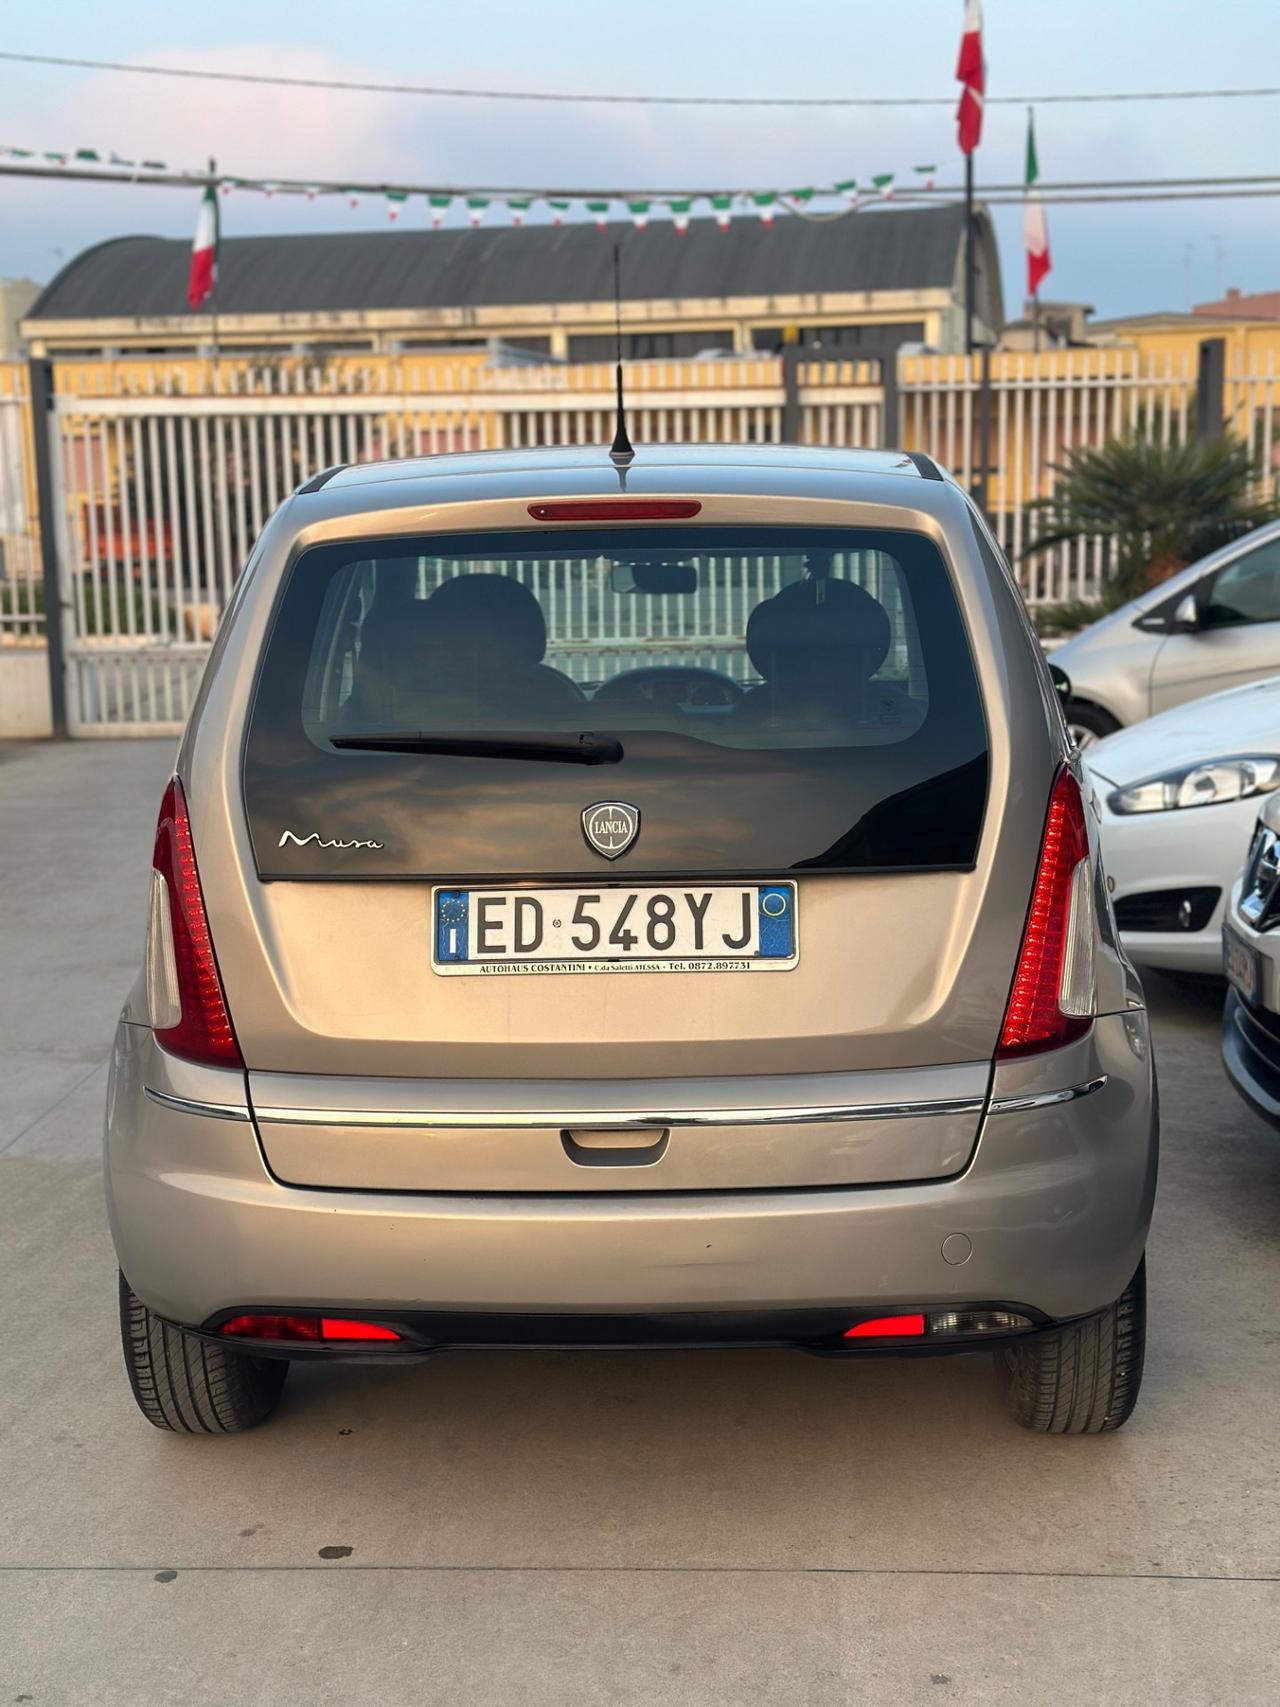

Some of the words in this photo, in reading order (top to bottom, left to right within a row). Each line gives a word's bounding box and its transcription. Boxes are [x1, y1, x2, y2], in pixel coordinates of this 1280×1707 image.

[594, 820, 628, 834] LANCIA
[278, 830, 384, 848] Musa
[477, 896, 543, 954] ED
[571, 892, 751, 952] 548YJ
[479, 964, 529, 973] AUTOHAUS
[530, 963, 586, 972] COSTANTINI
[611, 963, 634, 971] Saletti
[668, 962, 686, 970] Tel.
[688, 961, 750, 970] 0872.897731
